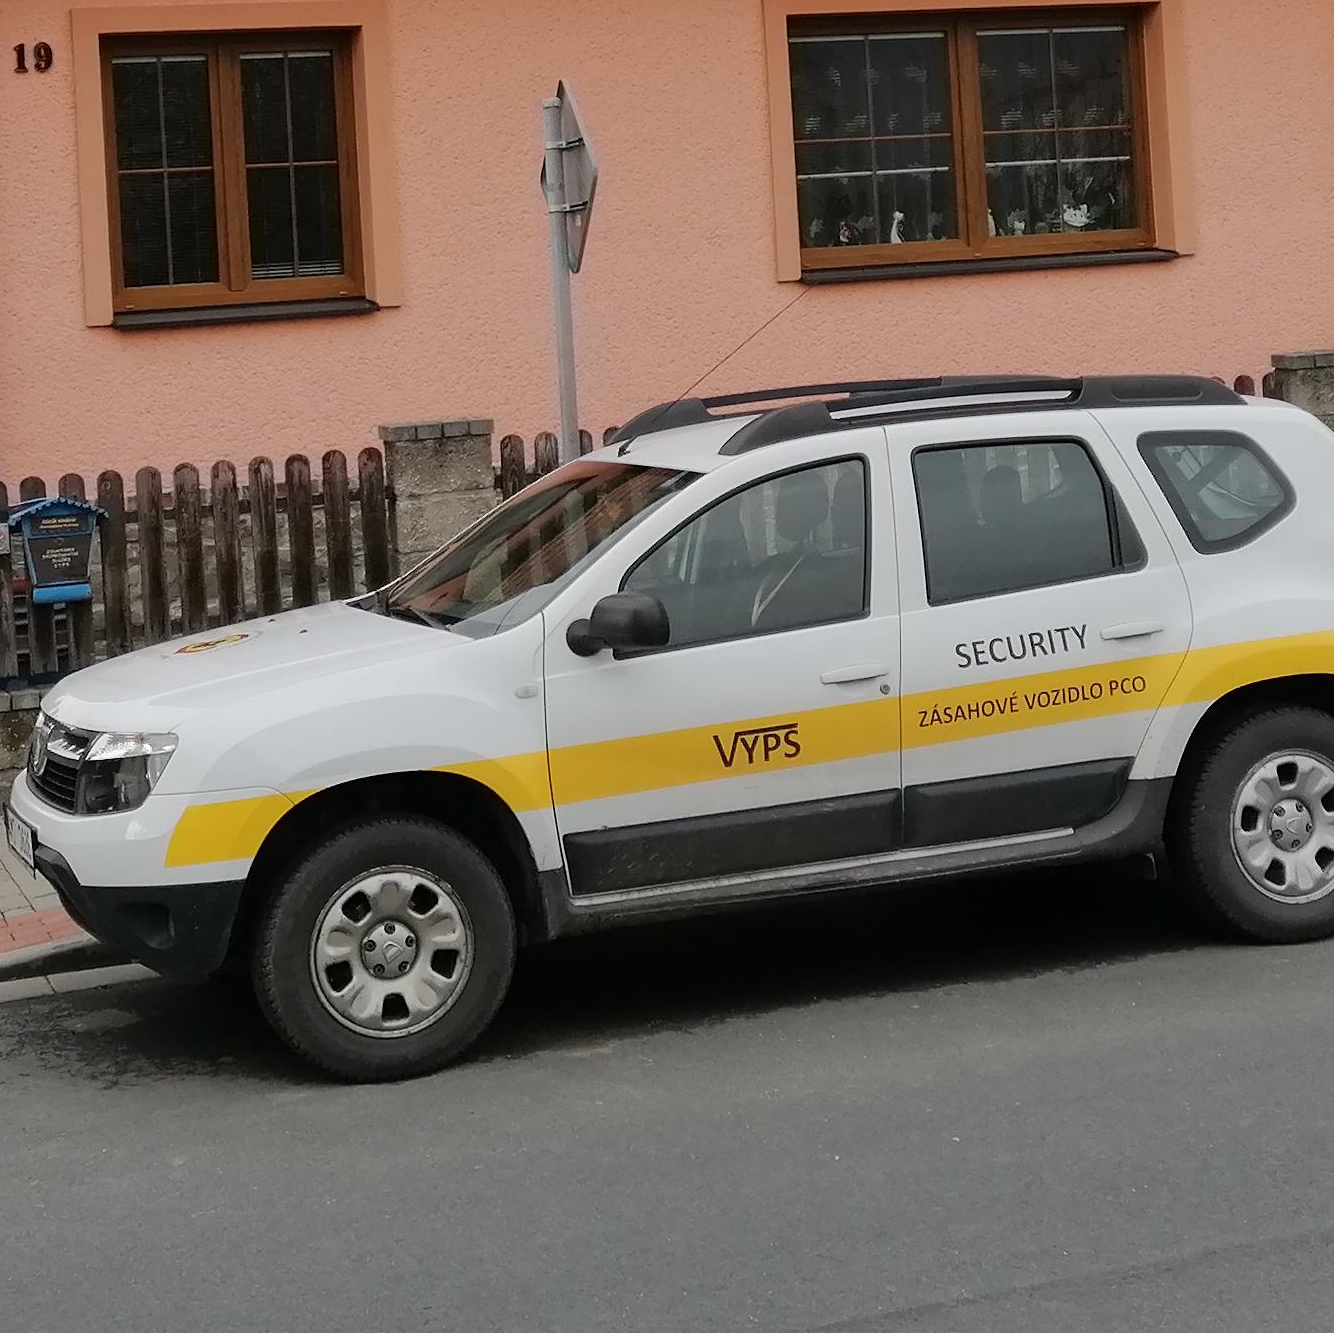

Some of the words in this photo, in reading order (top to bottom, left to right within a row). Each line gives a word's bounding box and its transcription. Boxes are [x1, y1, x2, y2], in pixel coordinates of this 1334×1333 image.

[12, 42, 52, 73] 19
[955, 624, 1087, 668] SECURITY
[918, 691, 1019, 728] ZÁSAHOVÉ
[1024, 682, 1103, 709] VOZIDLO
[1108, 675, 1147, 696] PCO
[712, 722, 801, 768] VYPS
